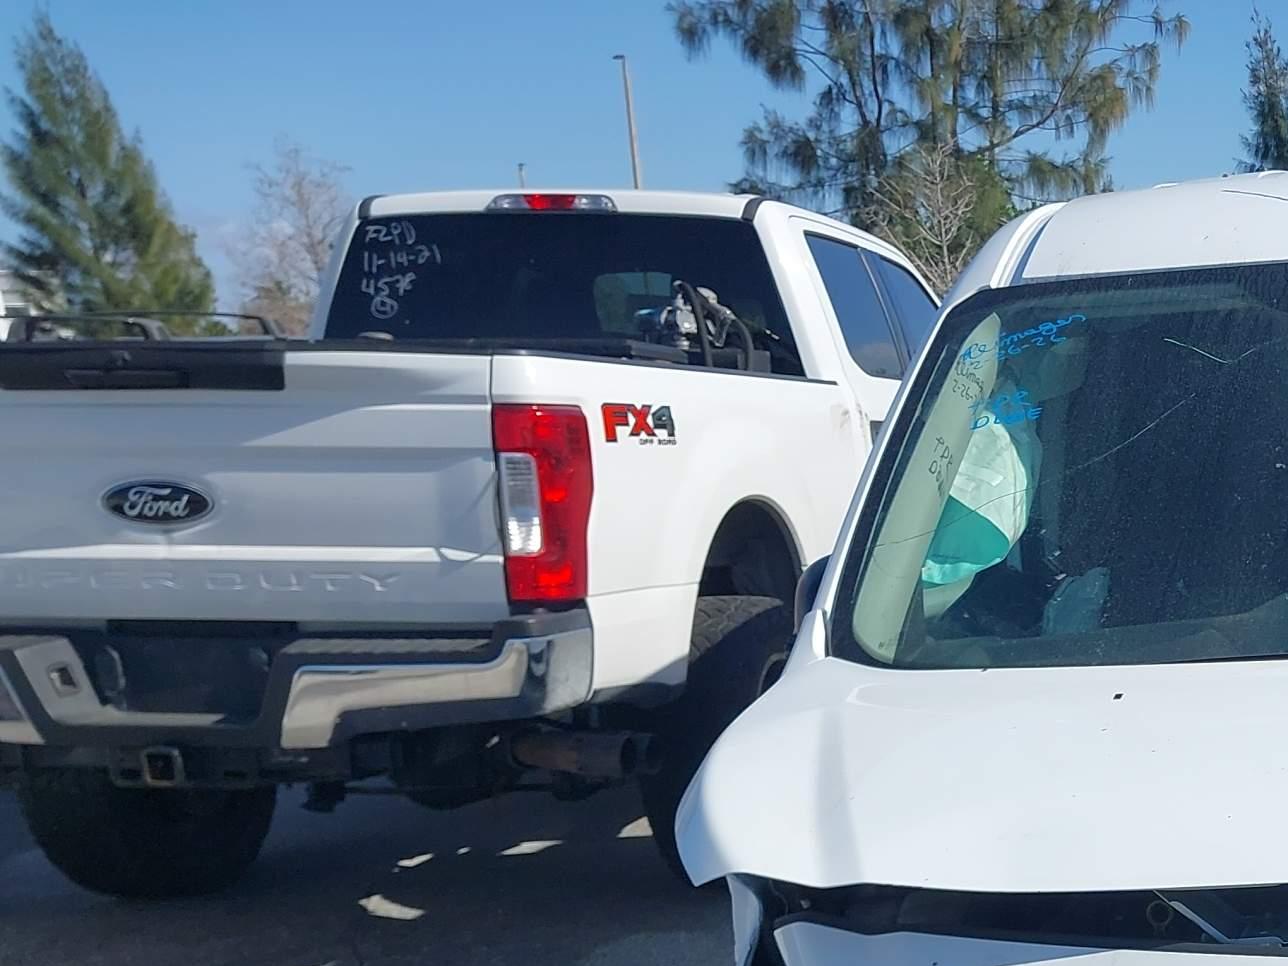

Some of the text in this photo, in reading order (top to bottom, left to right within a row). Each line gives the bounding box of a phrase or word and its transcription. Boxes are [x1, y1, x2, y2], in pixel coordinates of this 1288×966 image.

[601, 402, 675, 443] FX4
[123, 486, 190, 517] Ford
[207, 572, 400, 592] DUTY
